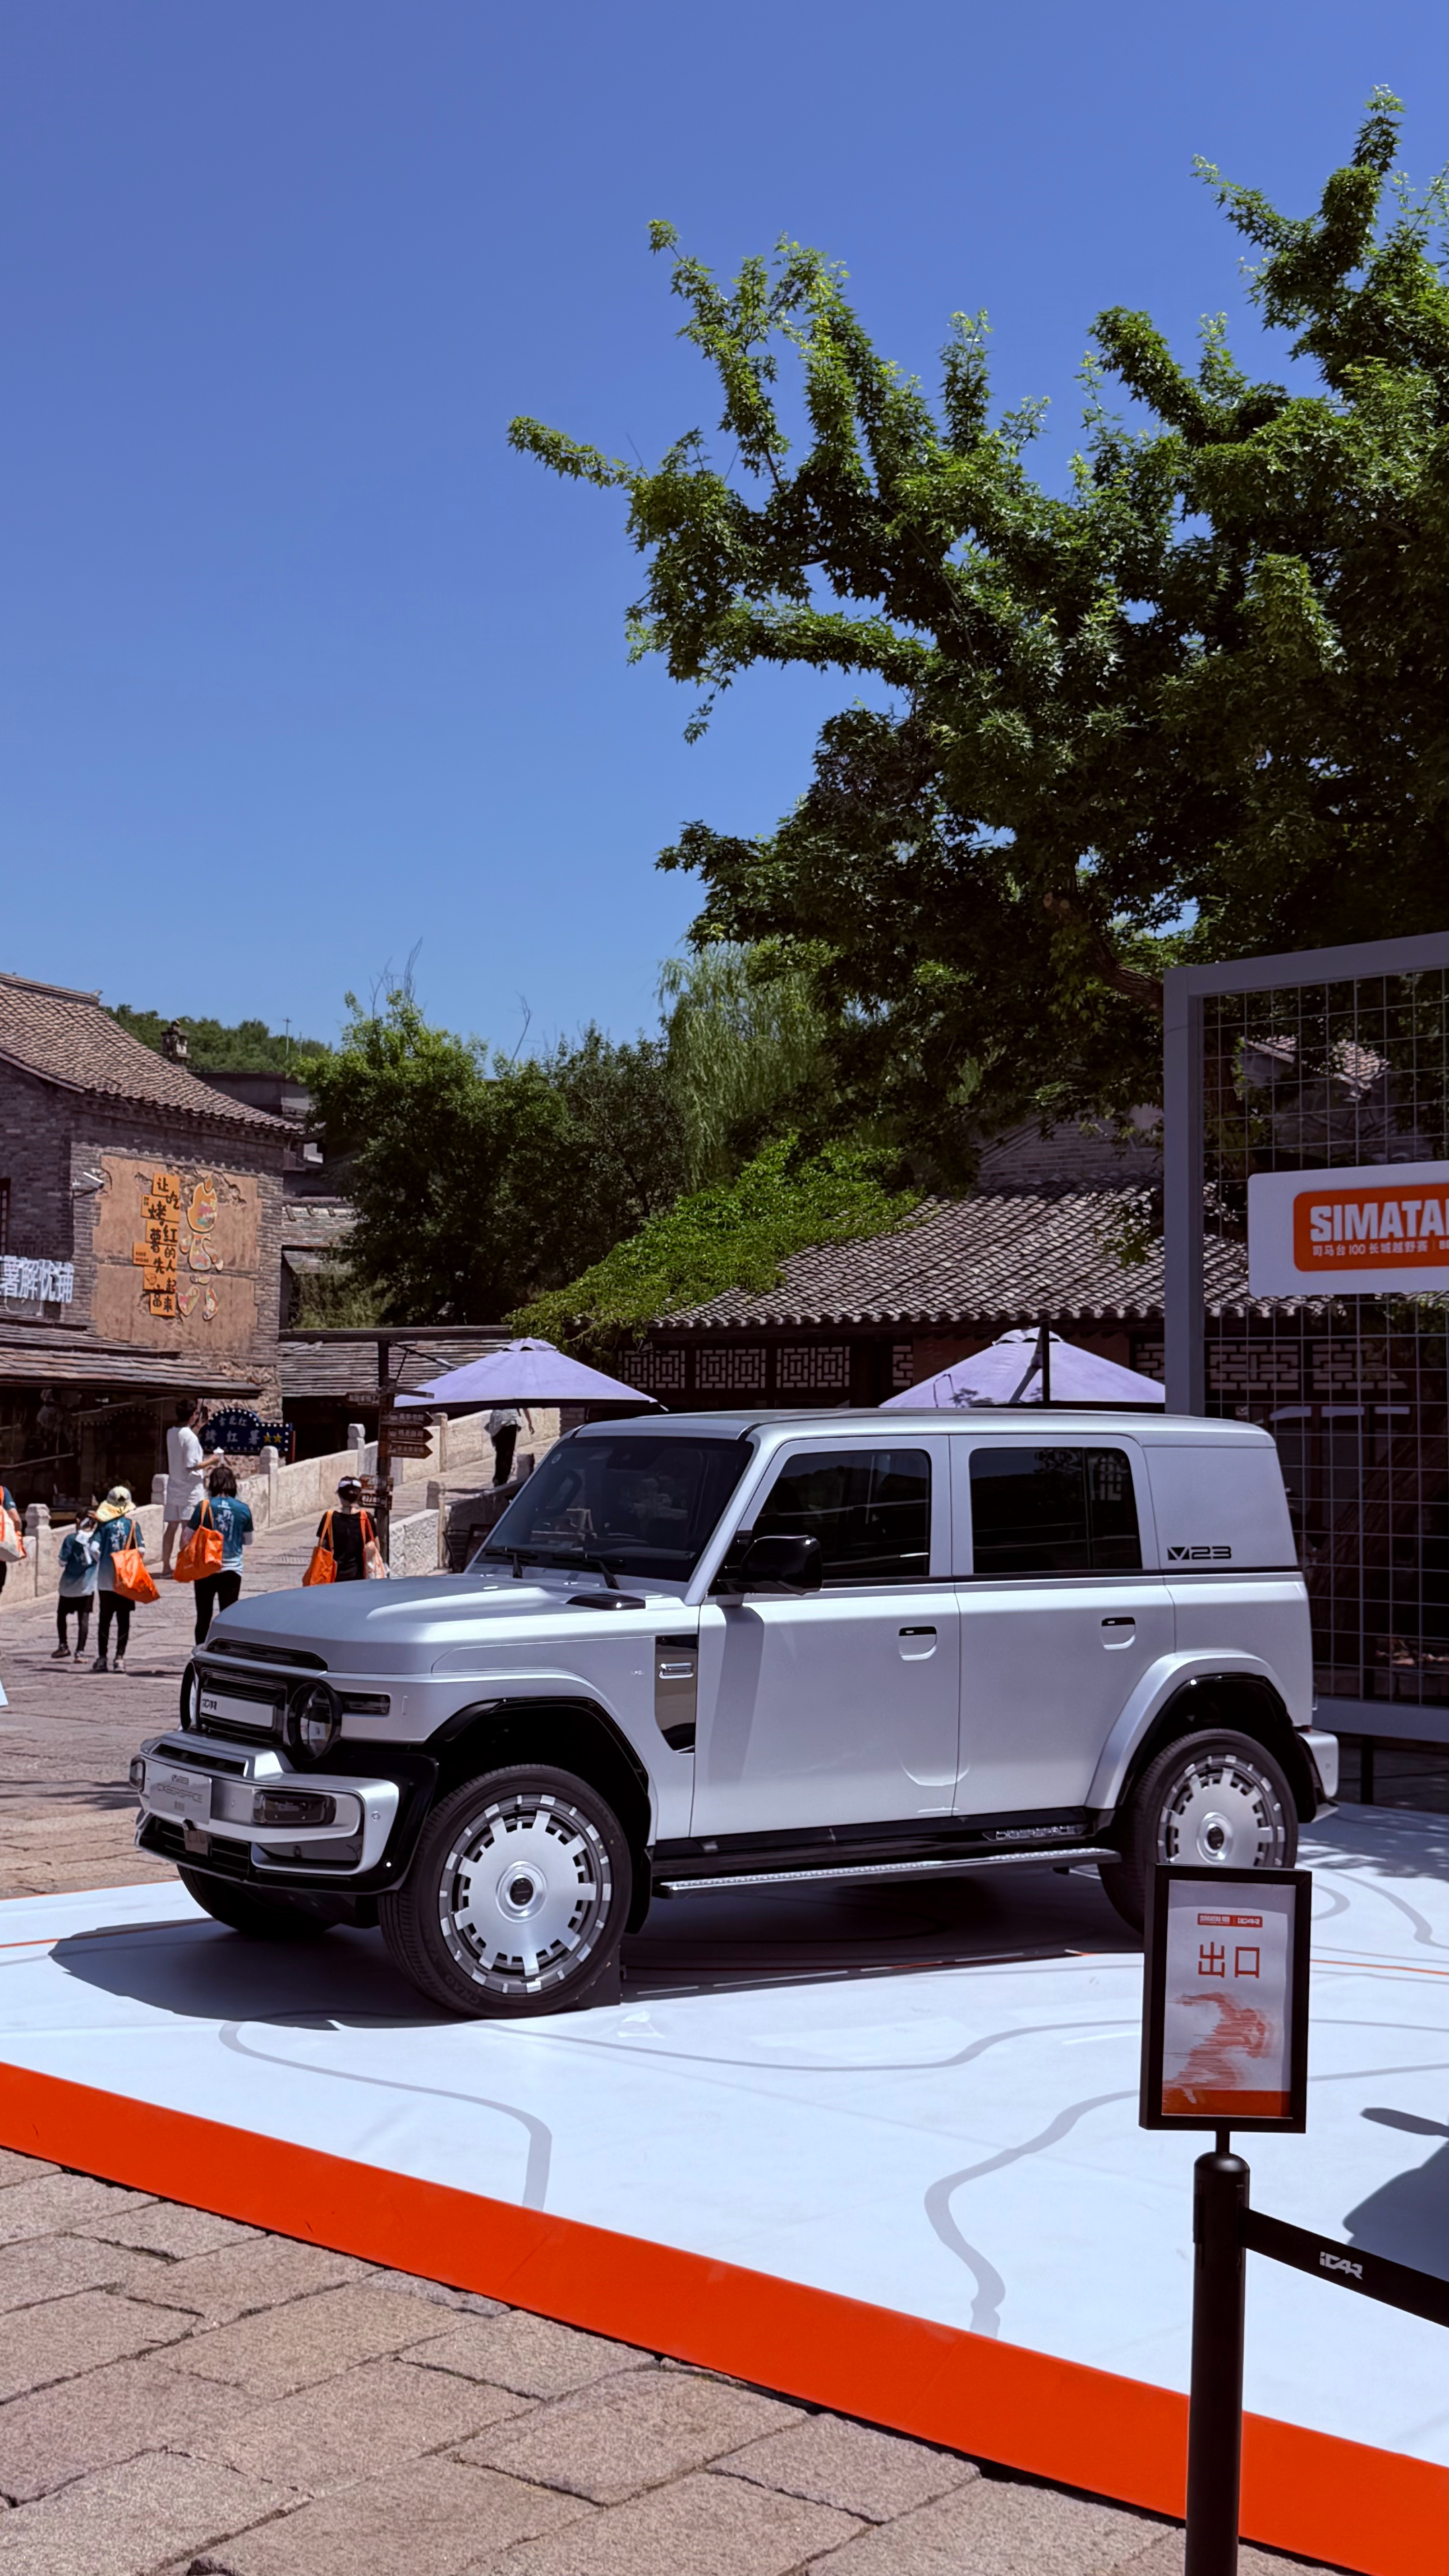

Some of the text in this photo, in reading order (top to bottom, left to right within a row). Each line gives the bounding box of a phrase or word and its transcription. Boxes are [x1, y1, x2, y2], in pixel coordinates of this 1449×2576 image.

[1167, 1546, 1232, 1560] V23
[1198, 1941, 1260, 1978] 出口
[1320, 2251, 1363, 2280] iCAR
